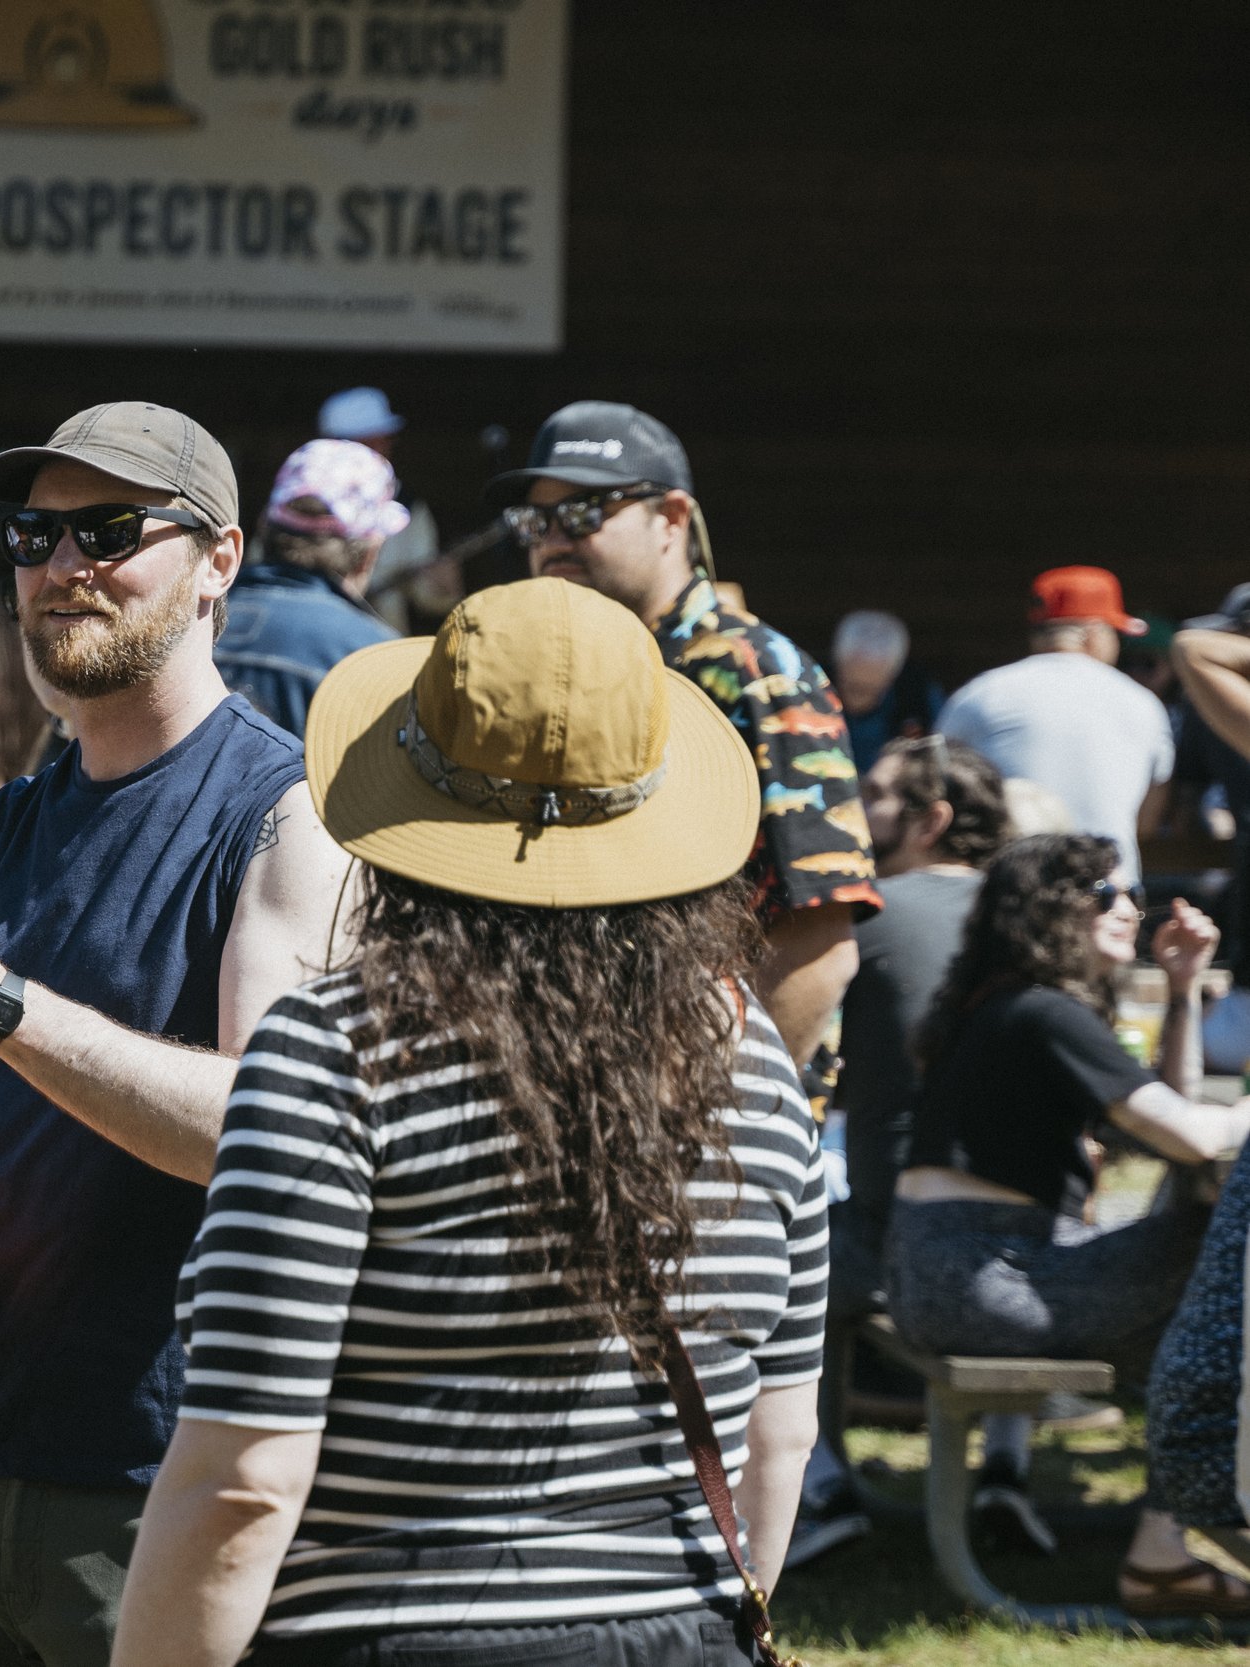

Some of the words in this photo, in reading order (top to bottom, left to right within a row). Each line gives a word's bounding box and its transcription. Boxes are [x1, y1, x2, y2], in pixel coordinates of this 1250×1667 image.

[210, 14, 343, 80] GOLD
[361, 16, 506, 83] RUSH
[337, 186, 530, 266] STAGE
